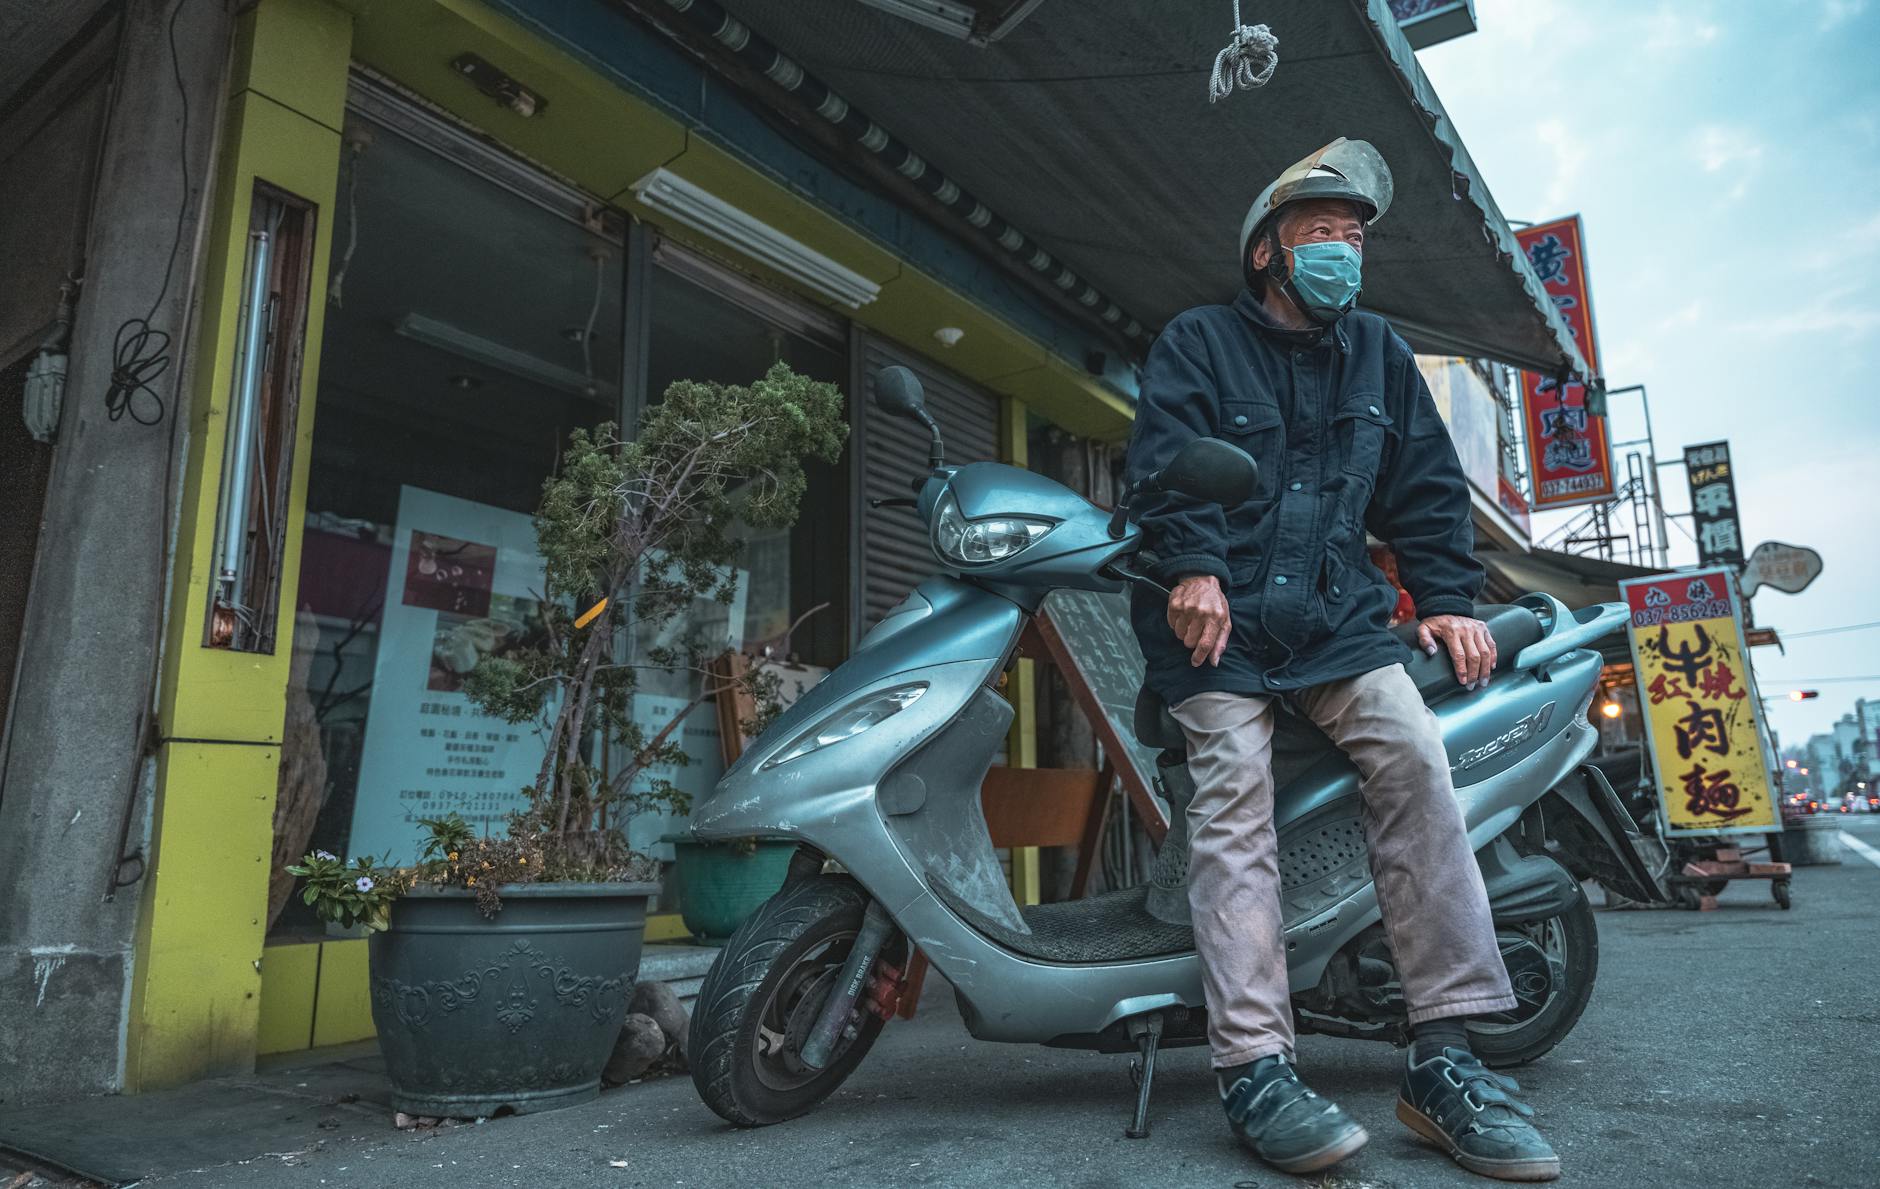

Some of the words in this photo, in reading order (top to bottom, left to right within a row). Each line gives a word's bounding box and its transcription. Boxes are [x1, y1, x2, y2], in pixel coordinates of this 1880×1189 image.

[1695, 482, 1738, 562] 平價
[1634, 601, 1731, 626] 037-856242
[1648, 662, 1747, 704] 紅燒
[848, 979, 860, 996] DISK
[855, 955, 872, 979] BRAKE
